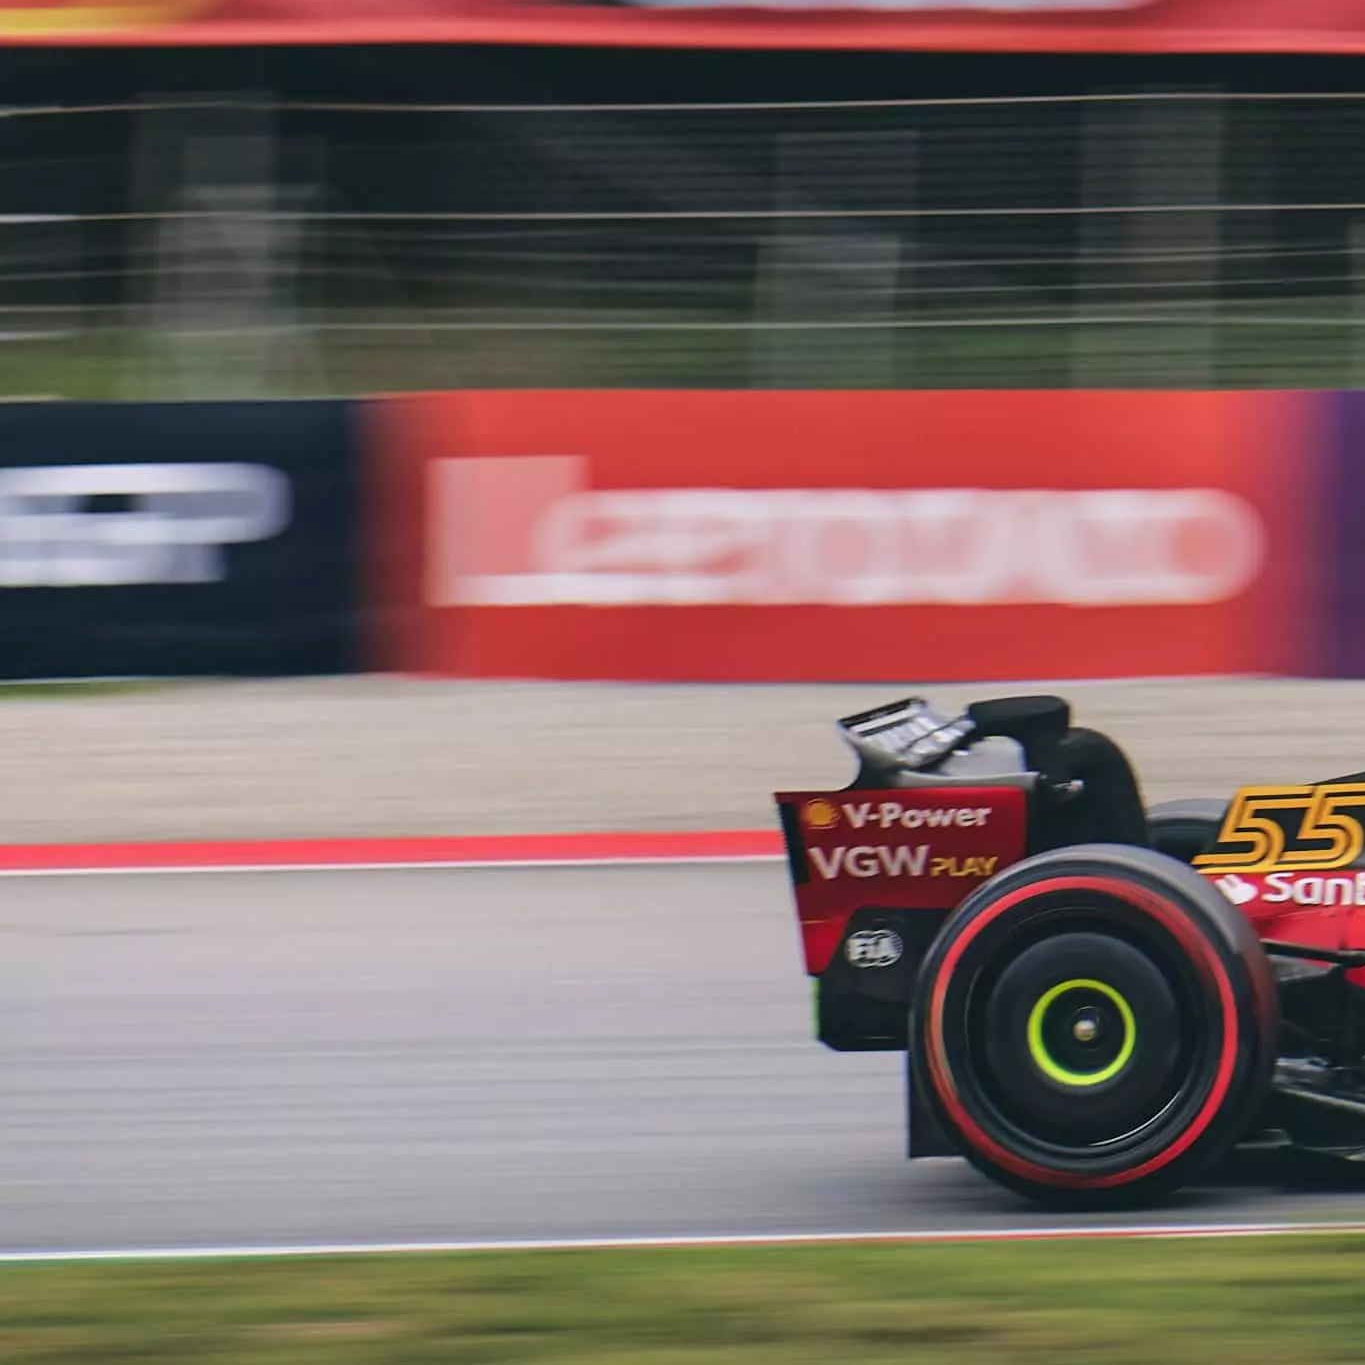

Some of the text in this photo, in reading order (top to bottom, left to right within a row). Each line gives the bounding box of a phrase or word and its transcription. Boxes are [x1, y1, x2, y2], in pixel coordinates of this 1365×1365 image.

[841, 801, 993, 829] V-Power
[808, 844, 999, 880] VGW PLAY
